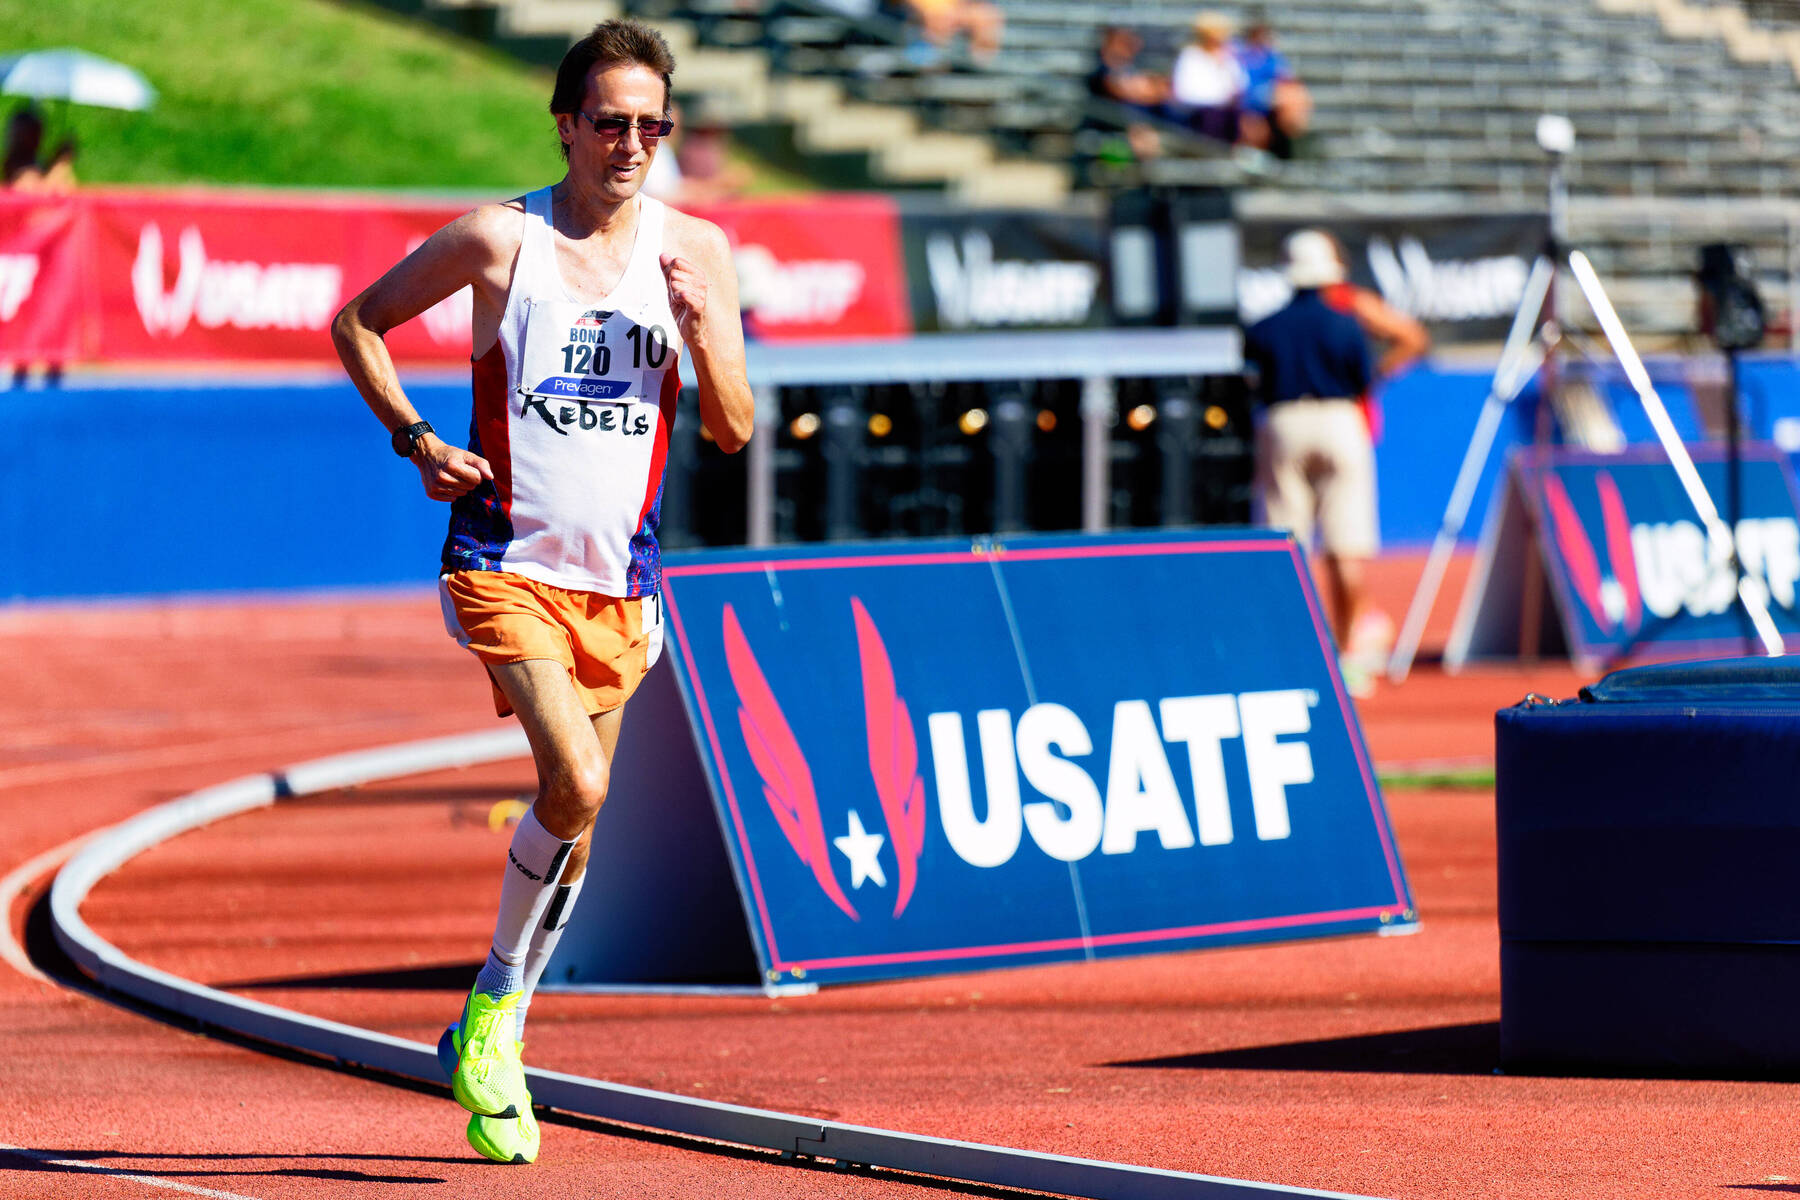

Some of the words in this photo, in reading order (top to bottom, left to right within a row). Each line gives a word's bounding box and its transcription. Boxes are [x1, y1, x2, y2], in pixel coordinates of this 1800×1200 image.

[570, 327, 606, 344] BOND
[626, 324, 668, 369] 10
[561, 344, 611, 376] 120
[554, 379, 612, 396] Prevagen
[517, 388, 650, 436] Rebels
[928, 689, 1315, 868] USATF
